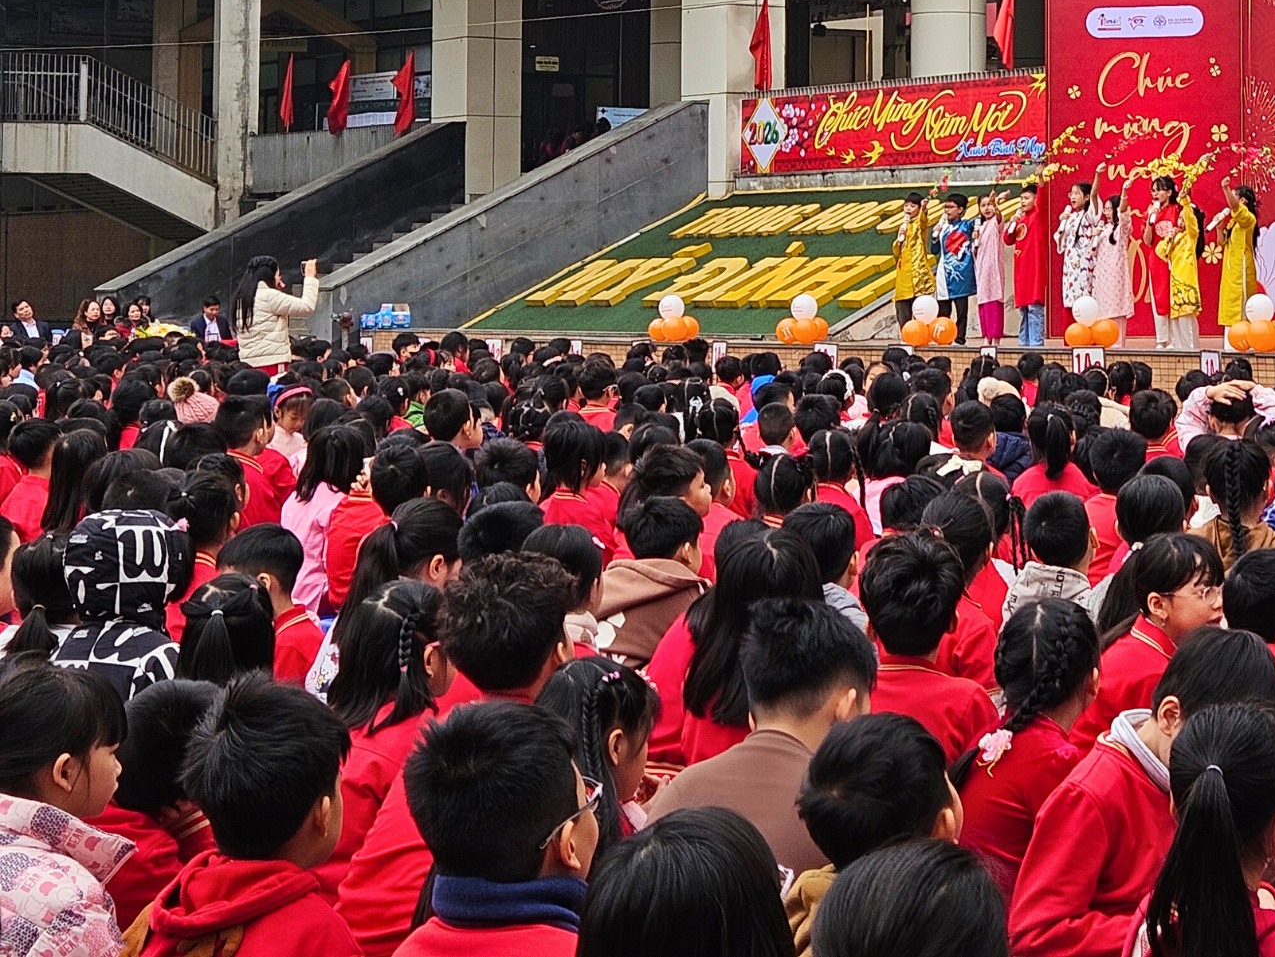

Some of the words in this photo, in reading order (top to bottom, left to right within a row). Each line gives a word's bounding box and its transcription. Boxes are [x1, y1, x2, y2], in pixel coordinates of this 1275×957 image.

[1097, 51, 1197, 108] Chúc
[749, 119, 780, 145] 2026
[1094, 113, 1197, 163] mừng
[524, 241, 698, 307] MỸ
